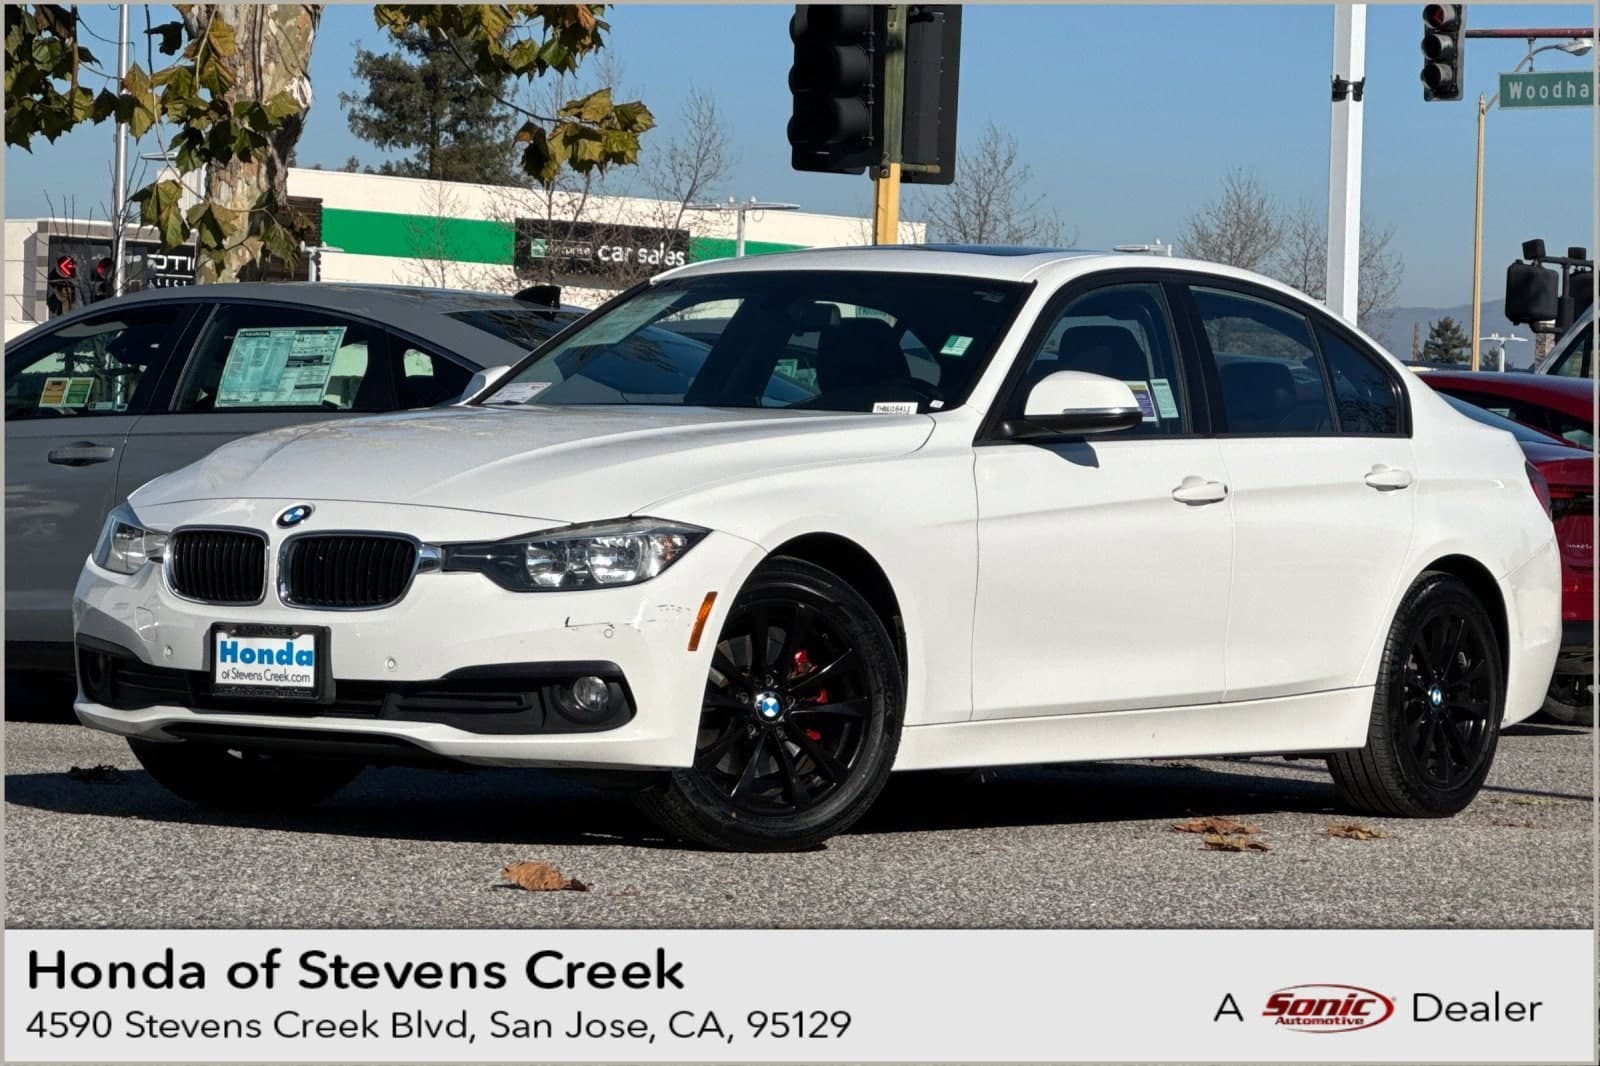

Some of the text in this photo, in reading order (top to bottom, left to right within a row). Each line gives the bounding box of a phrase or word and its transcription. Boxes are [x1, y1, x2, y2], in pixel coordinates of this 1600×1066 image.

[1508, 80, 1590, 100] Woodha
[597, 244, 633, 263] car
[637, 241, 686, 267] sales
[220, 640, 313, 666] Honda
[221, 667, 311, 684] of Stevens Creek.com
